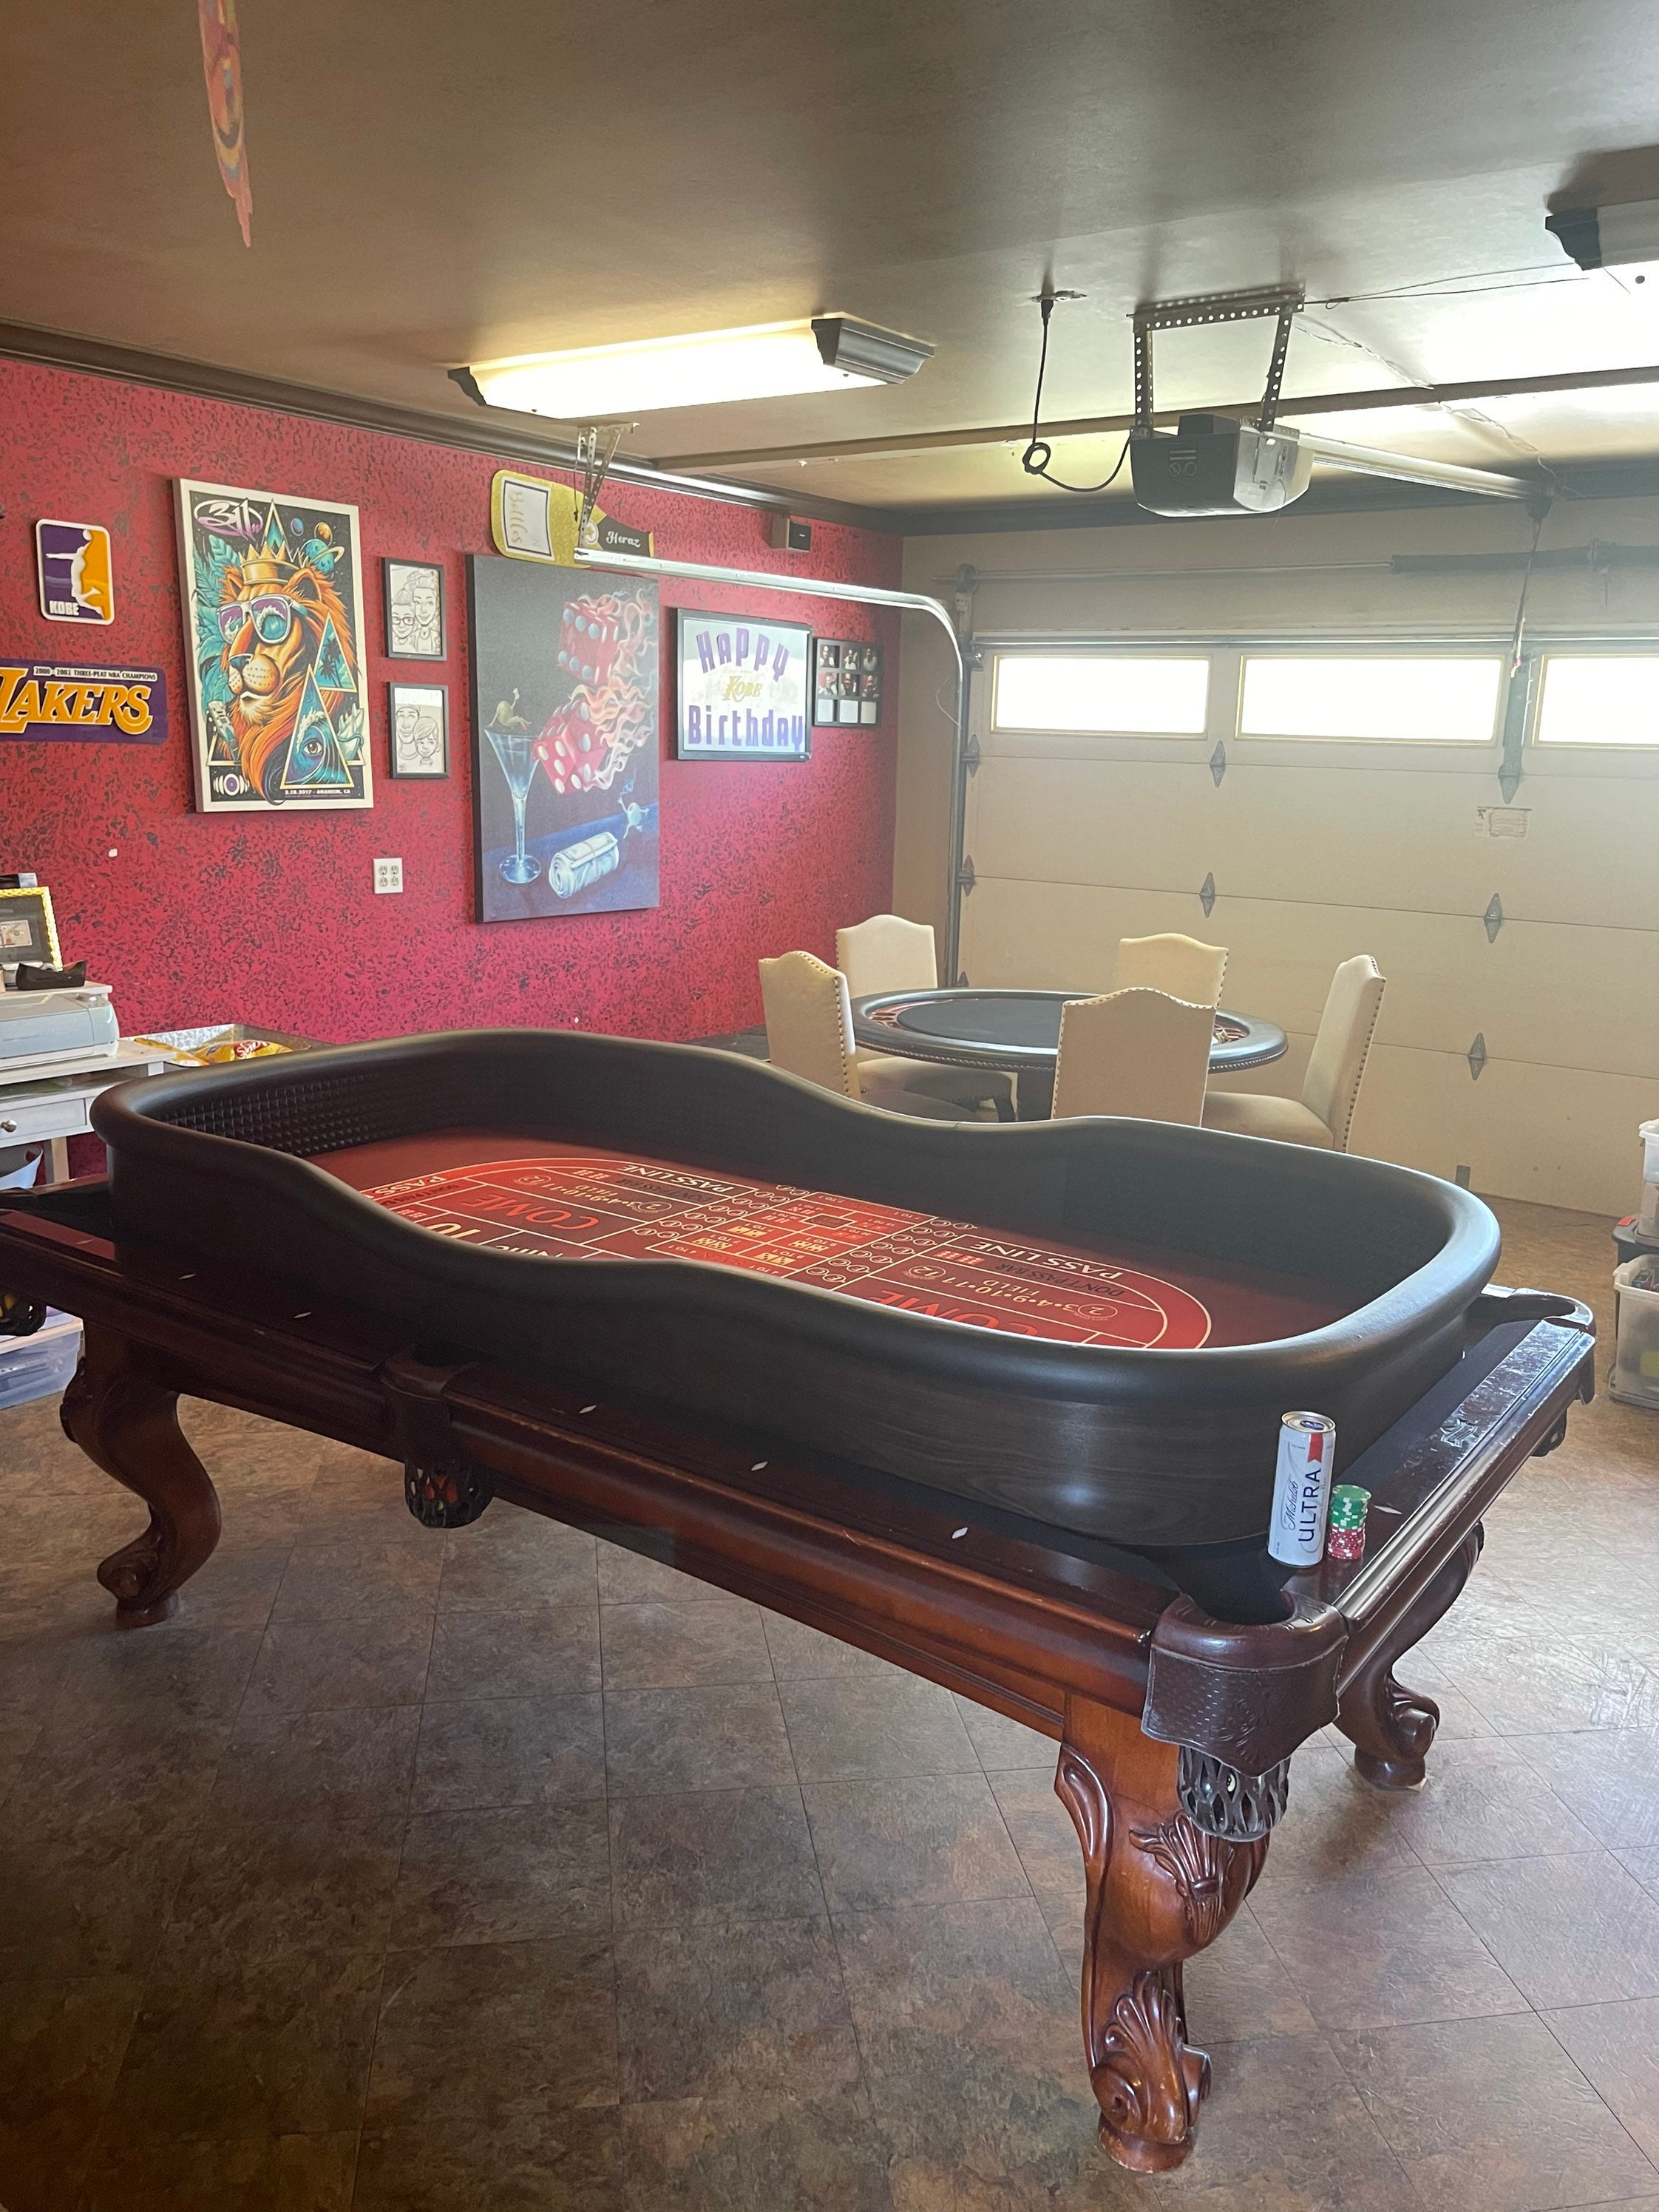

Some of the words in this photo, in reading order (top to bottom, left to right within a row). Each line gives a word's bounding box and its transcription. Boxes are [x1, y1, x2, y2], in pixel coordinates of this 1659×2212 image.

[605, 531, 642, 548] Heraz
[49, 600, 80, 616] KOBE
[696, 627, 790, 682] HAPPY
[74, 670, 107, 678] THREE-PEAT
[122, 672, 157, 681] CHAMPIONS
[688, 705, 803, 753] Birthday
[617, 1164, 674, 1179] LINE
[374, 1175, 447, 1195] PASS
[574, 1185, 618, 1197] FIELD
[671, 1176, 734, 1192] PASS
[459, 1193, 599, 1230] COME
[970, 1241, 1042, 1261] LINE
[914, 1266, 939, 1277] 12
[1042, 1257, 1124, 1280] PASS
[983, 1279, 1040, 1297] FIELD
[1288, 1479, 1300, 1530] Michelob
[1298, 1468, 1322, 1542] ULTRA
